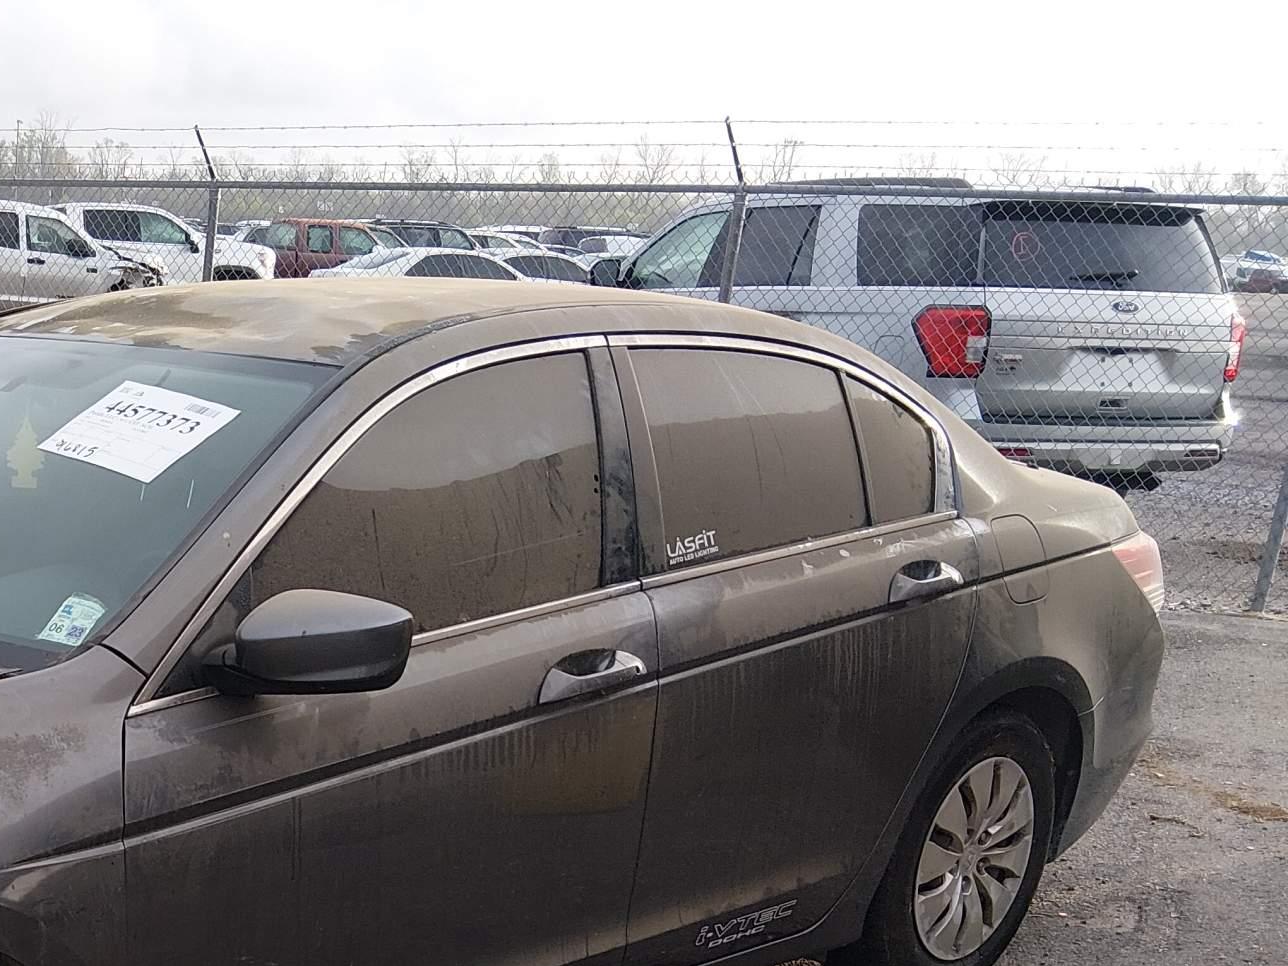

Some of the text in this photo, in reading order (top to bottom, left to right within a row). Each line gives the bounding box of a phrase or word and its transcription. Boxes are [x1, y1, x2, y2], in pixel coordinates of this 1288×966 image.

[105, 400, 201, 434] 44577373
[669, 556, 684, 565] AUTO
[684, 553, 695, 561] LED
[48, 622, 84, 638] 06 23
